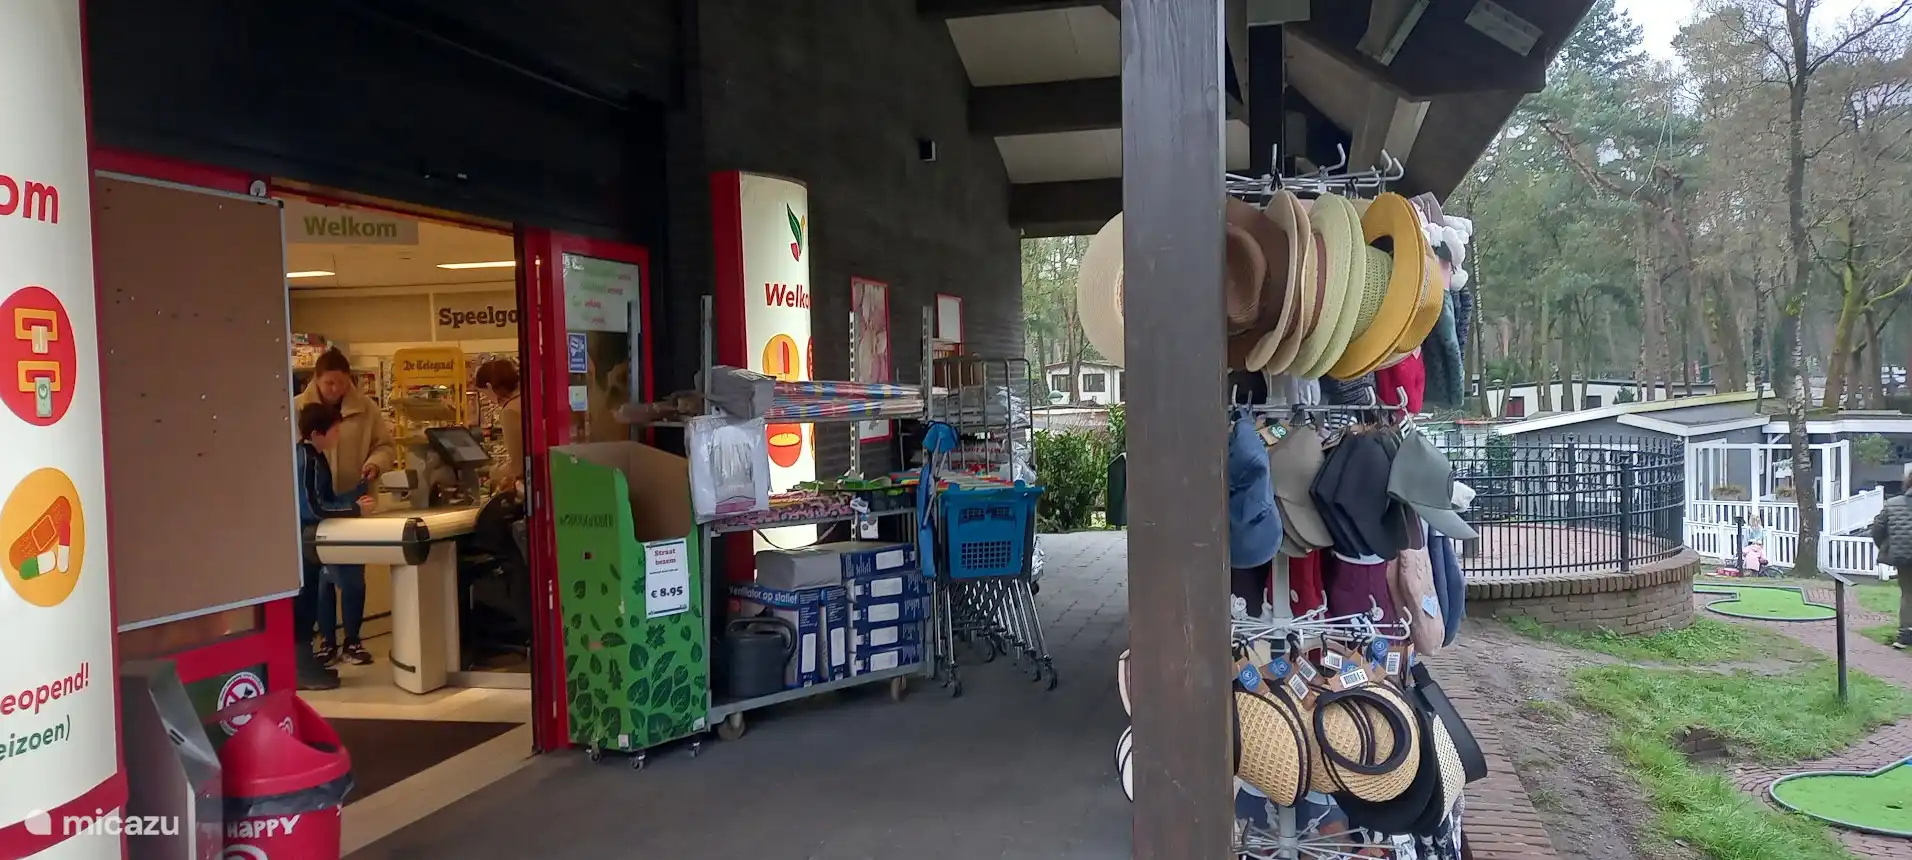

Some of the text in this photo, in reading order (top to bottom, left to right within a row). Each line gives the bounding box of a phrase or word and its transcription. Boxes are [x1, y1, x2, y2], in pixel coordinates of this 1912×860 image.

[303, 215, 398, 237] Welkom
[403, 359, 454, 372] De Telegraaf
[654, 548, 676, 557] Straat
[655, 558, 677, 566] bezem
[651, 586, 683, 599] € 8.95
[728, 585, 761, 599] Ventilator
[762, 591, 773, 601] op
[0, 662, 89, 715] eopend!
